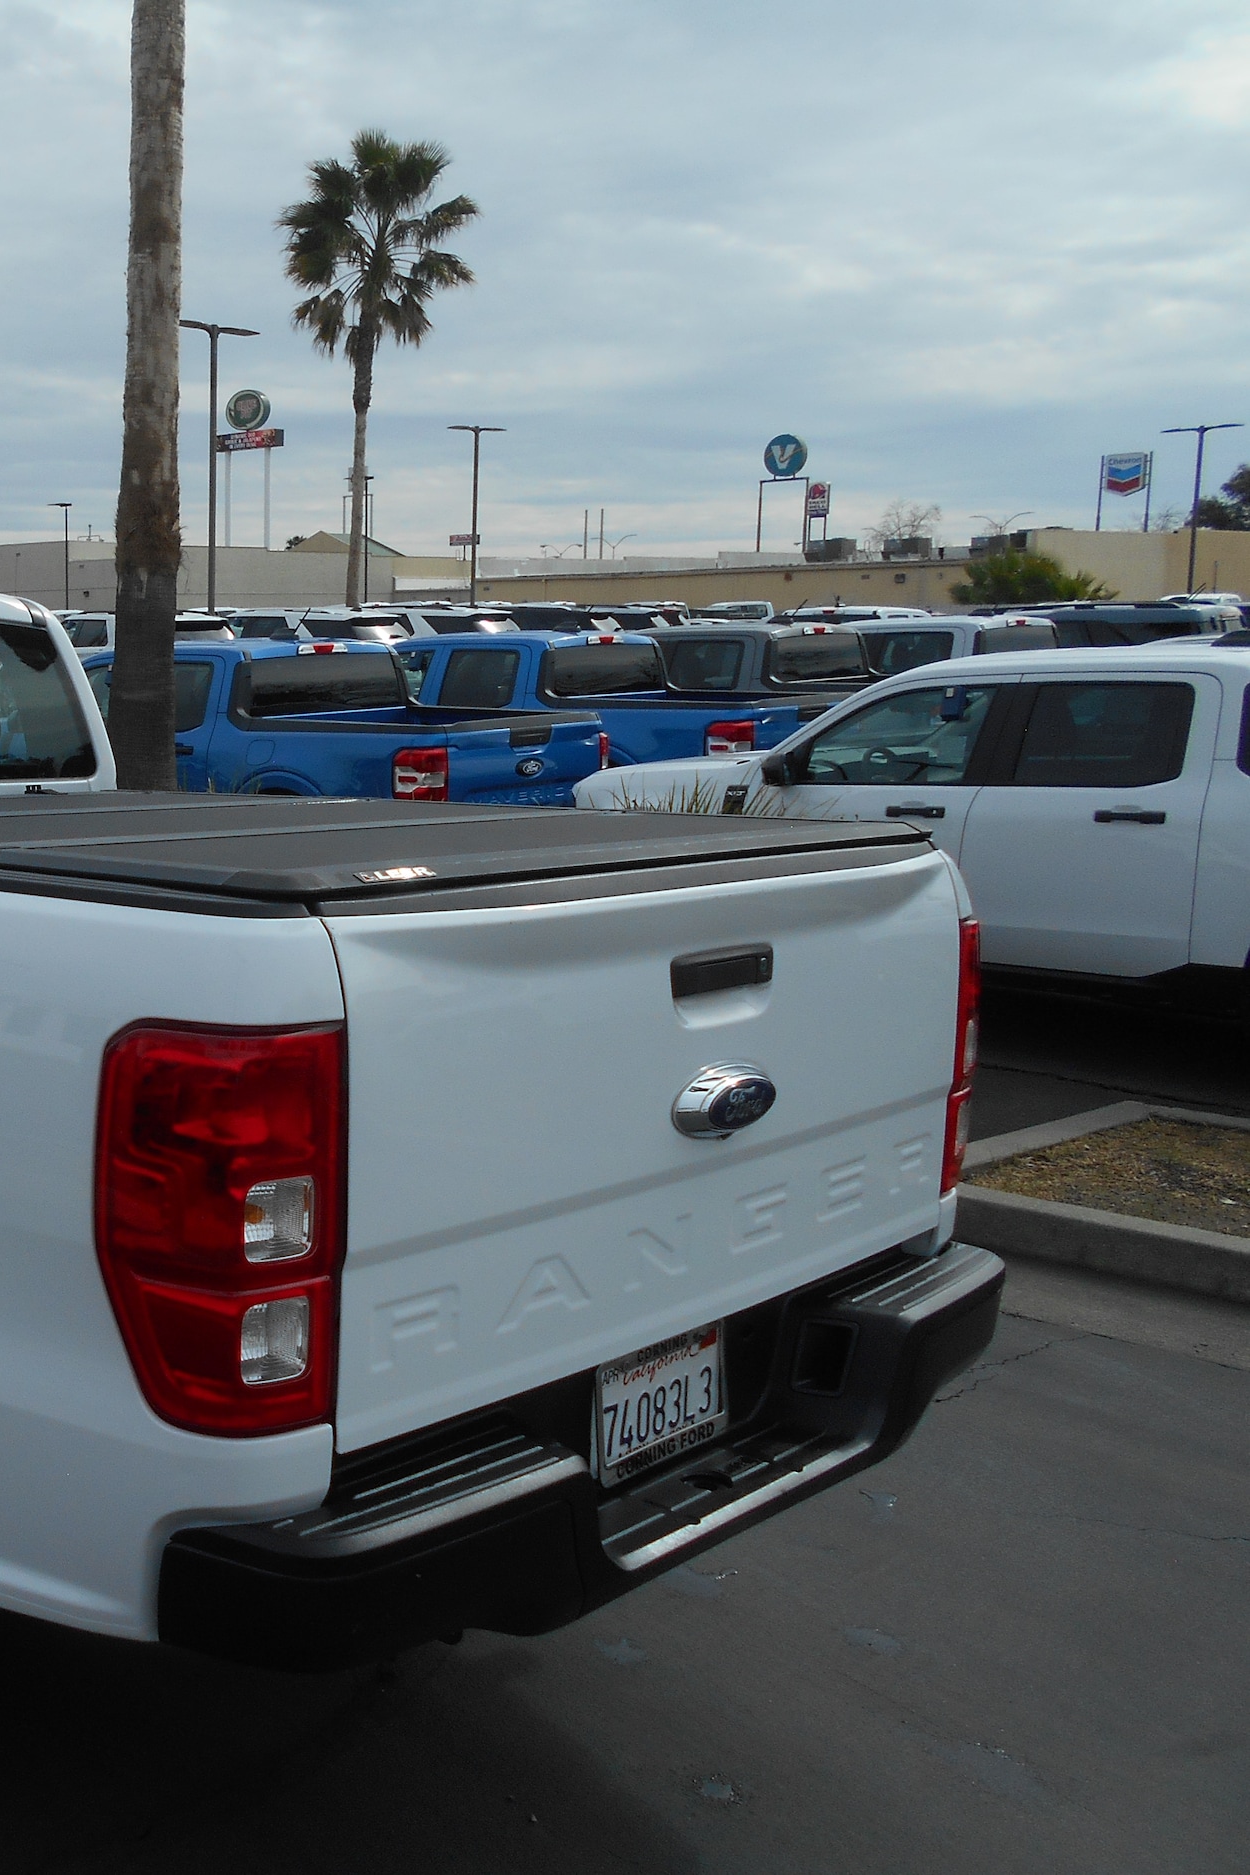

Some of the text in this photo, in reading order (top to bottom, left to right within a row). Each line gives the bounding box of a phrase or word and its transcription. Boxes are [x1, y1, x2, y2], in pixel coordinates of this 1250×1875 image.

[1108, 457, 1142, 466] Chevron
[371, 1132, 932, 1374] RANGER
[623, 1345, 699, 1386] California
[603, 1365, 713, 1458] 74083L3
[616, 1440, 677, 1479] CORNING
[680, 1421, 715, 1449] FORD
